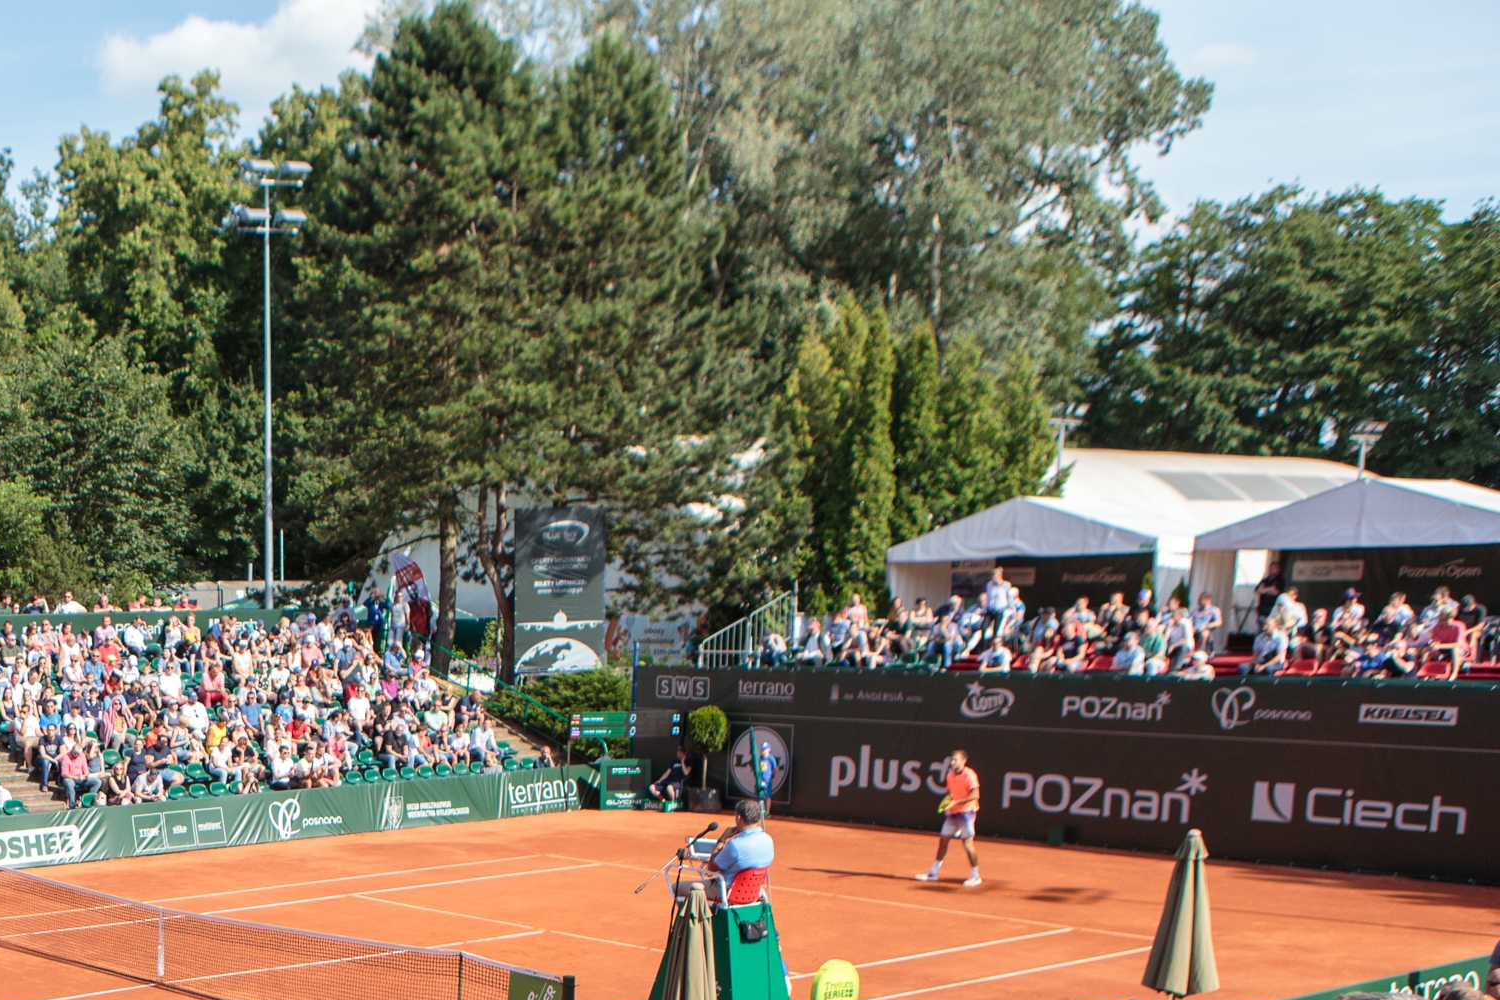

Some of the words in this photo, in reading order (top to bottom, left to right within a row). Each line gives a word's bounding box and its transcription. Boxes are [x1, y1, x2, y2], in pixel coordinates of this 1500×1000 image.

[738, 678, 795, 695] terrano
[829, 745, 922, 797] plus
[508, 778, 578, 805] terrano
[301, 814, 343, 828] posnania
[1304, 787, 1468, 836] Ciech
